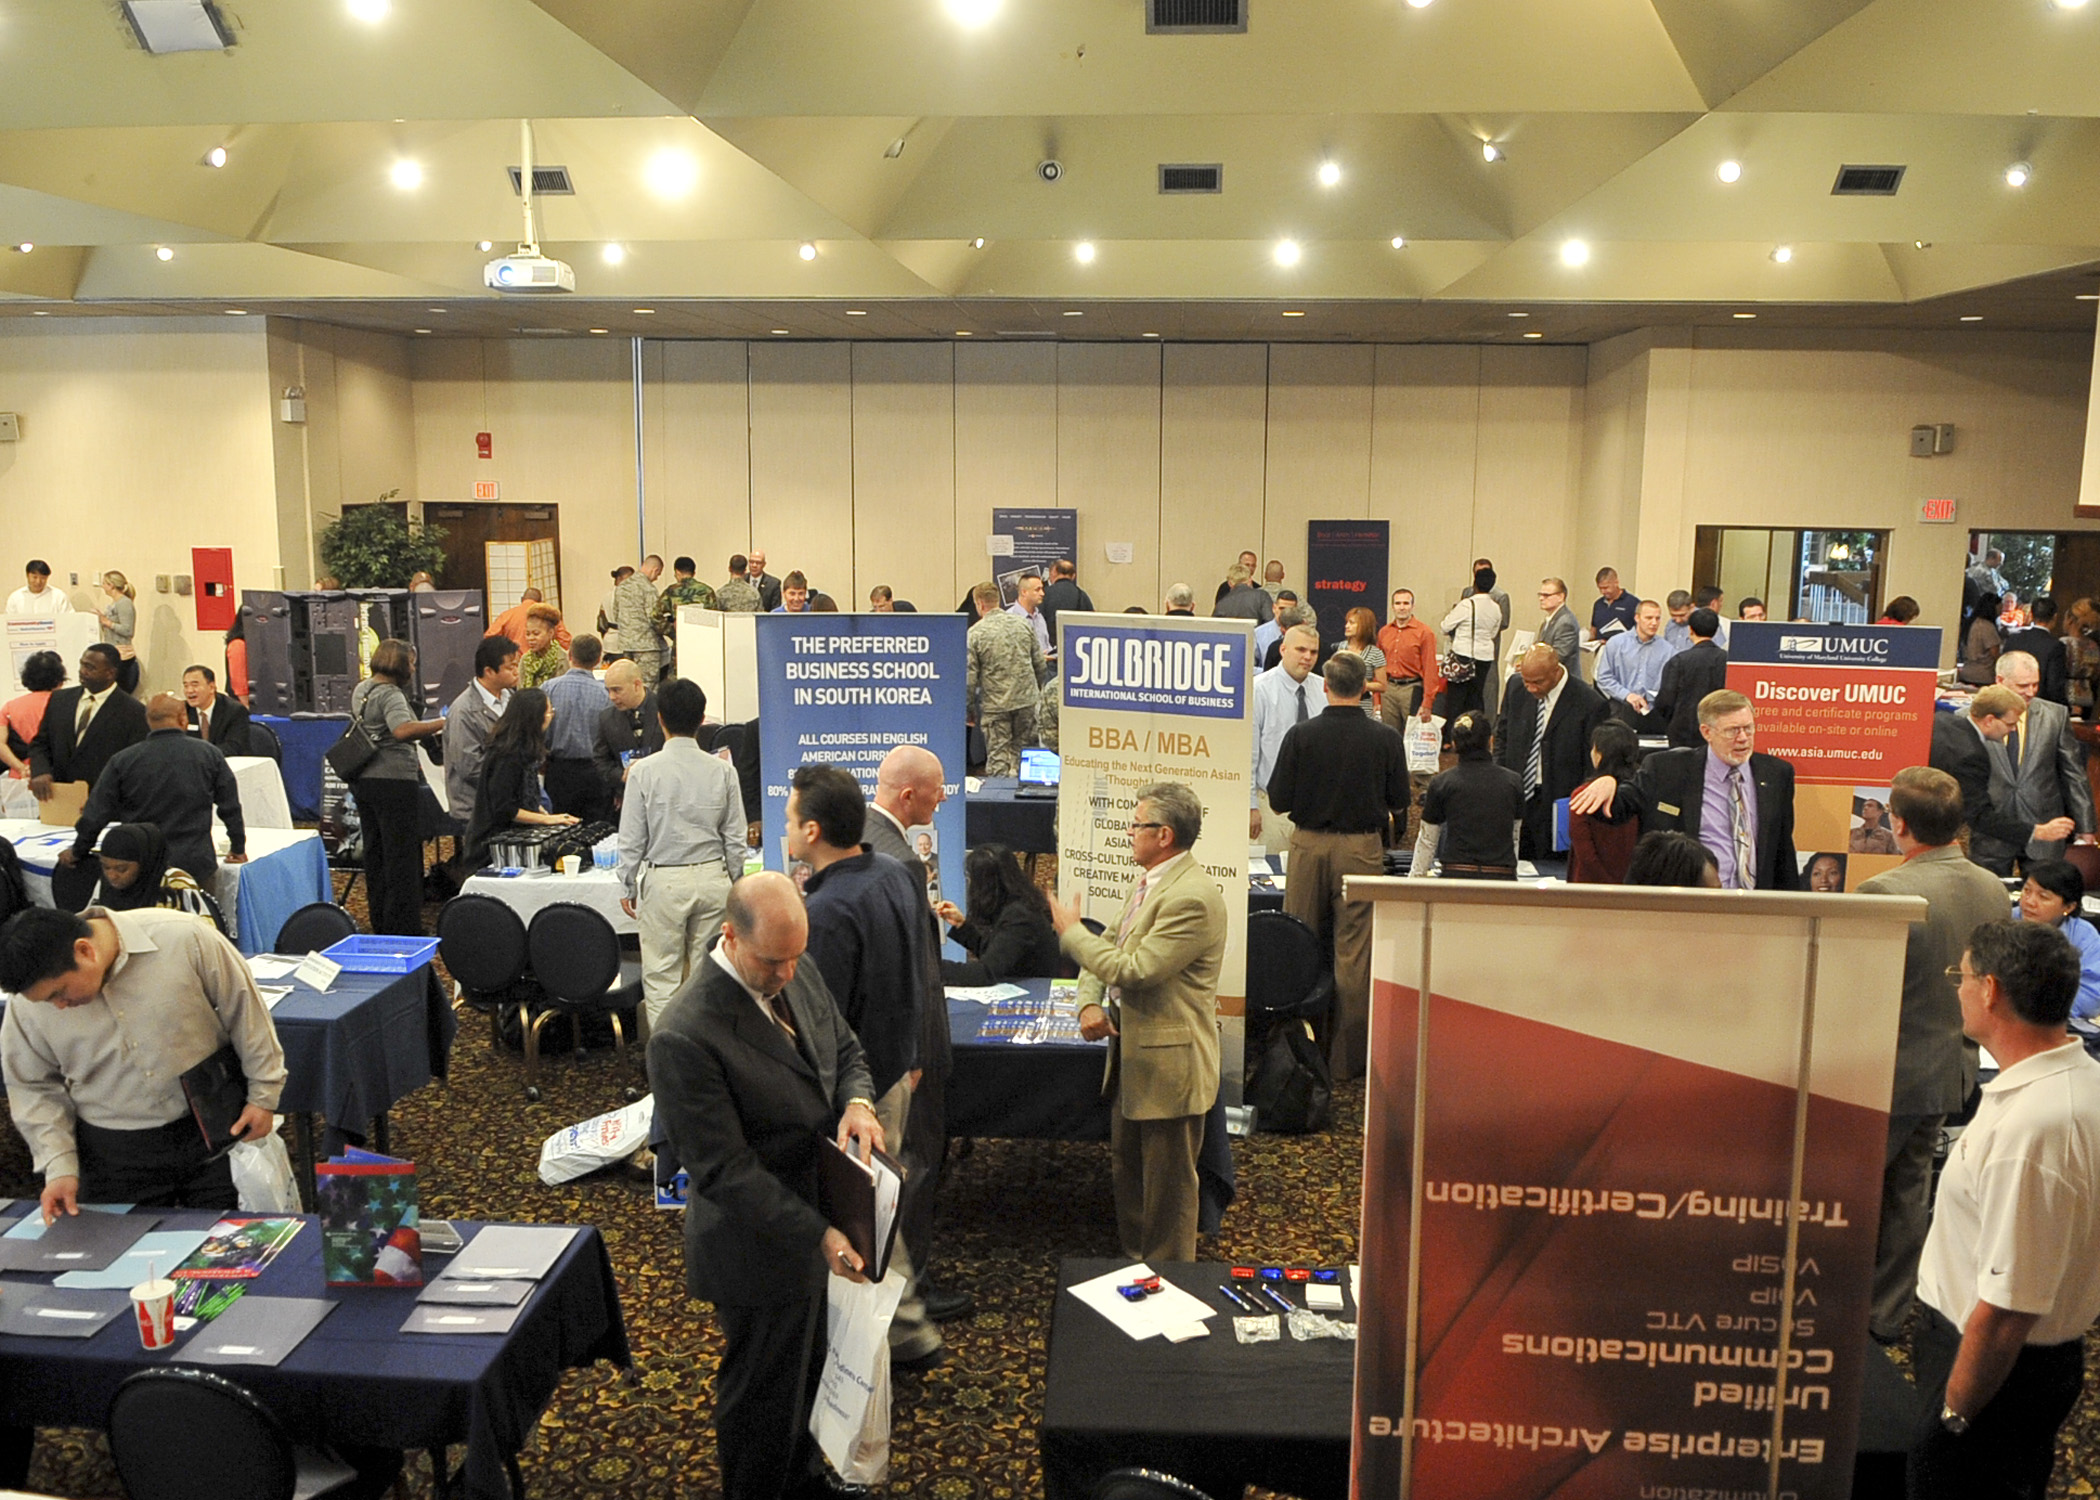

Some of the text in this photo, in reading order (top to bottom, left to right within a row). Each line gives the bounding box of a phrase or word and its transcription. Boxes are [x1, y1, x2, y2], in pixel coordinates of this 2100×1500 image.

[476, 482, 495, 498] EXIT
[1926, 499, 1954, 519] EXIT
[1314, 580, 1367, 592] strategy
[791, 636, 930, 655] THE PREFERRED
[1825, 637, 1889, 655] UMUC
[786, 662, 940, 680] BUSINESS SCHOOL
[1070, 636, 1235, 694] SOLBRIDGE
[794, 688, 932, 705] IN SOUTH KOREA
[1070, 688, 1234, 709] INTERNATIONAL SCHOOL OF BUSINESS
[1755, 681, 1907, 704] Discover UMUC
[1783, 706, 1803, 717] and
[1805, 707, 1861, 719] certificate
[1864, 710, 1918, 722] programs
[1756, 721, 1898, 737] available on-site or online
[798, 733, 928, 745] ALL COURSES IN ENGLISH
[1089, 726, 1210, 758] BBA / MBA
[801, 750, 856, 763] AMERICAN
[1767, 746, 1883, 761] www.asia.umuc.edu
[1064, 755, 1241, 782] Educating the Next Generation Asian
[767, 785, 789, 797] 80%
[1089, 796, 1115, 809] WITH
[1073, 867, 1119, 883] CREATIVE
[1088, 885, 1123, 900] SOCIAL
[1732, 1255, 1821, 1275] VSIP
[1750, 1286, 1818, 1306] VIP
[1646, 1311, 1816, 1337] Scure VTC
[1502, 1333, 1834, 1374] Communications
[1623, 1431, 1825, 1464] Enterprise
